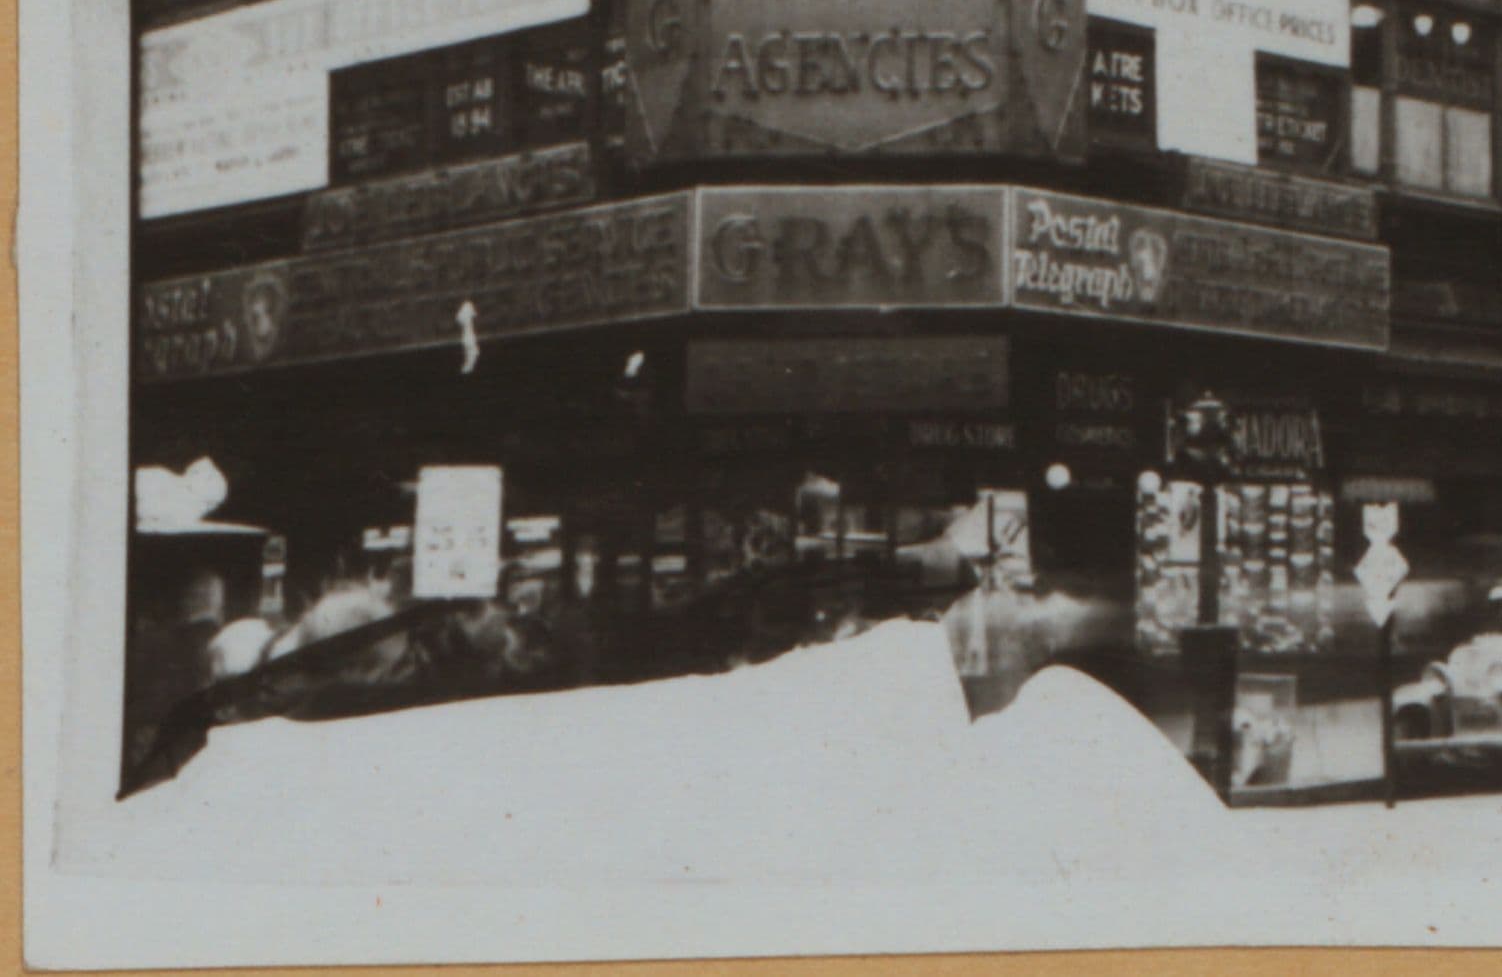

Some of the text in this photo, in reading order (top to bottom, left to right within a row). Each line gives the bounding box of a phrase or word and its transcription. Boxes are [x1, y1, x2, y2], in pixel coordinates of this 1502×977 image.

[711, 29, 996, 99] AGENCIES
[1027, 200, 1121, 255] Postal
[1014, 248, 1134, 308] Telegraph
